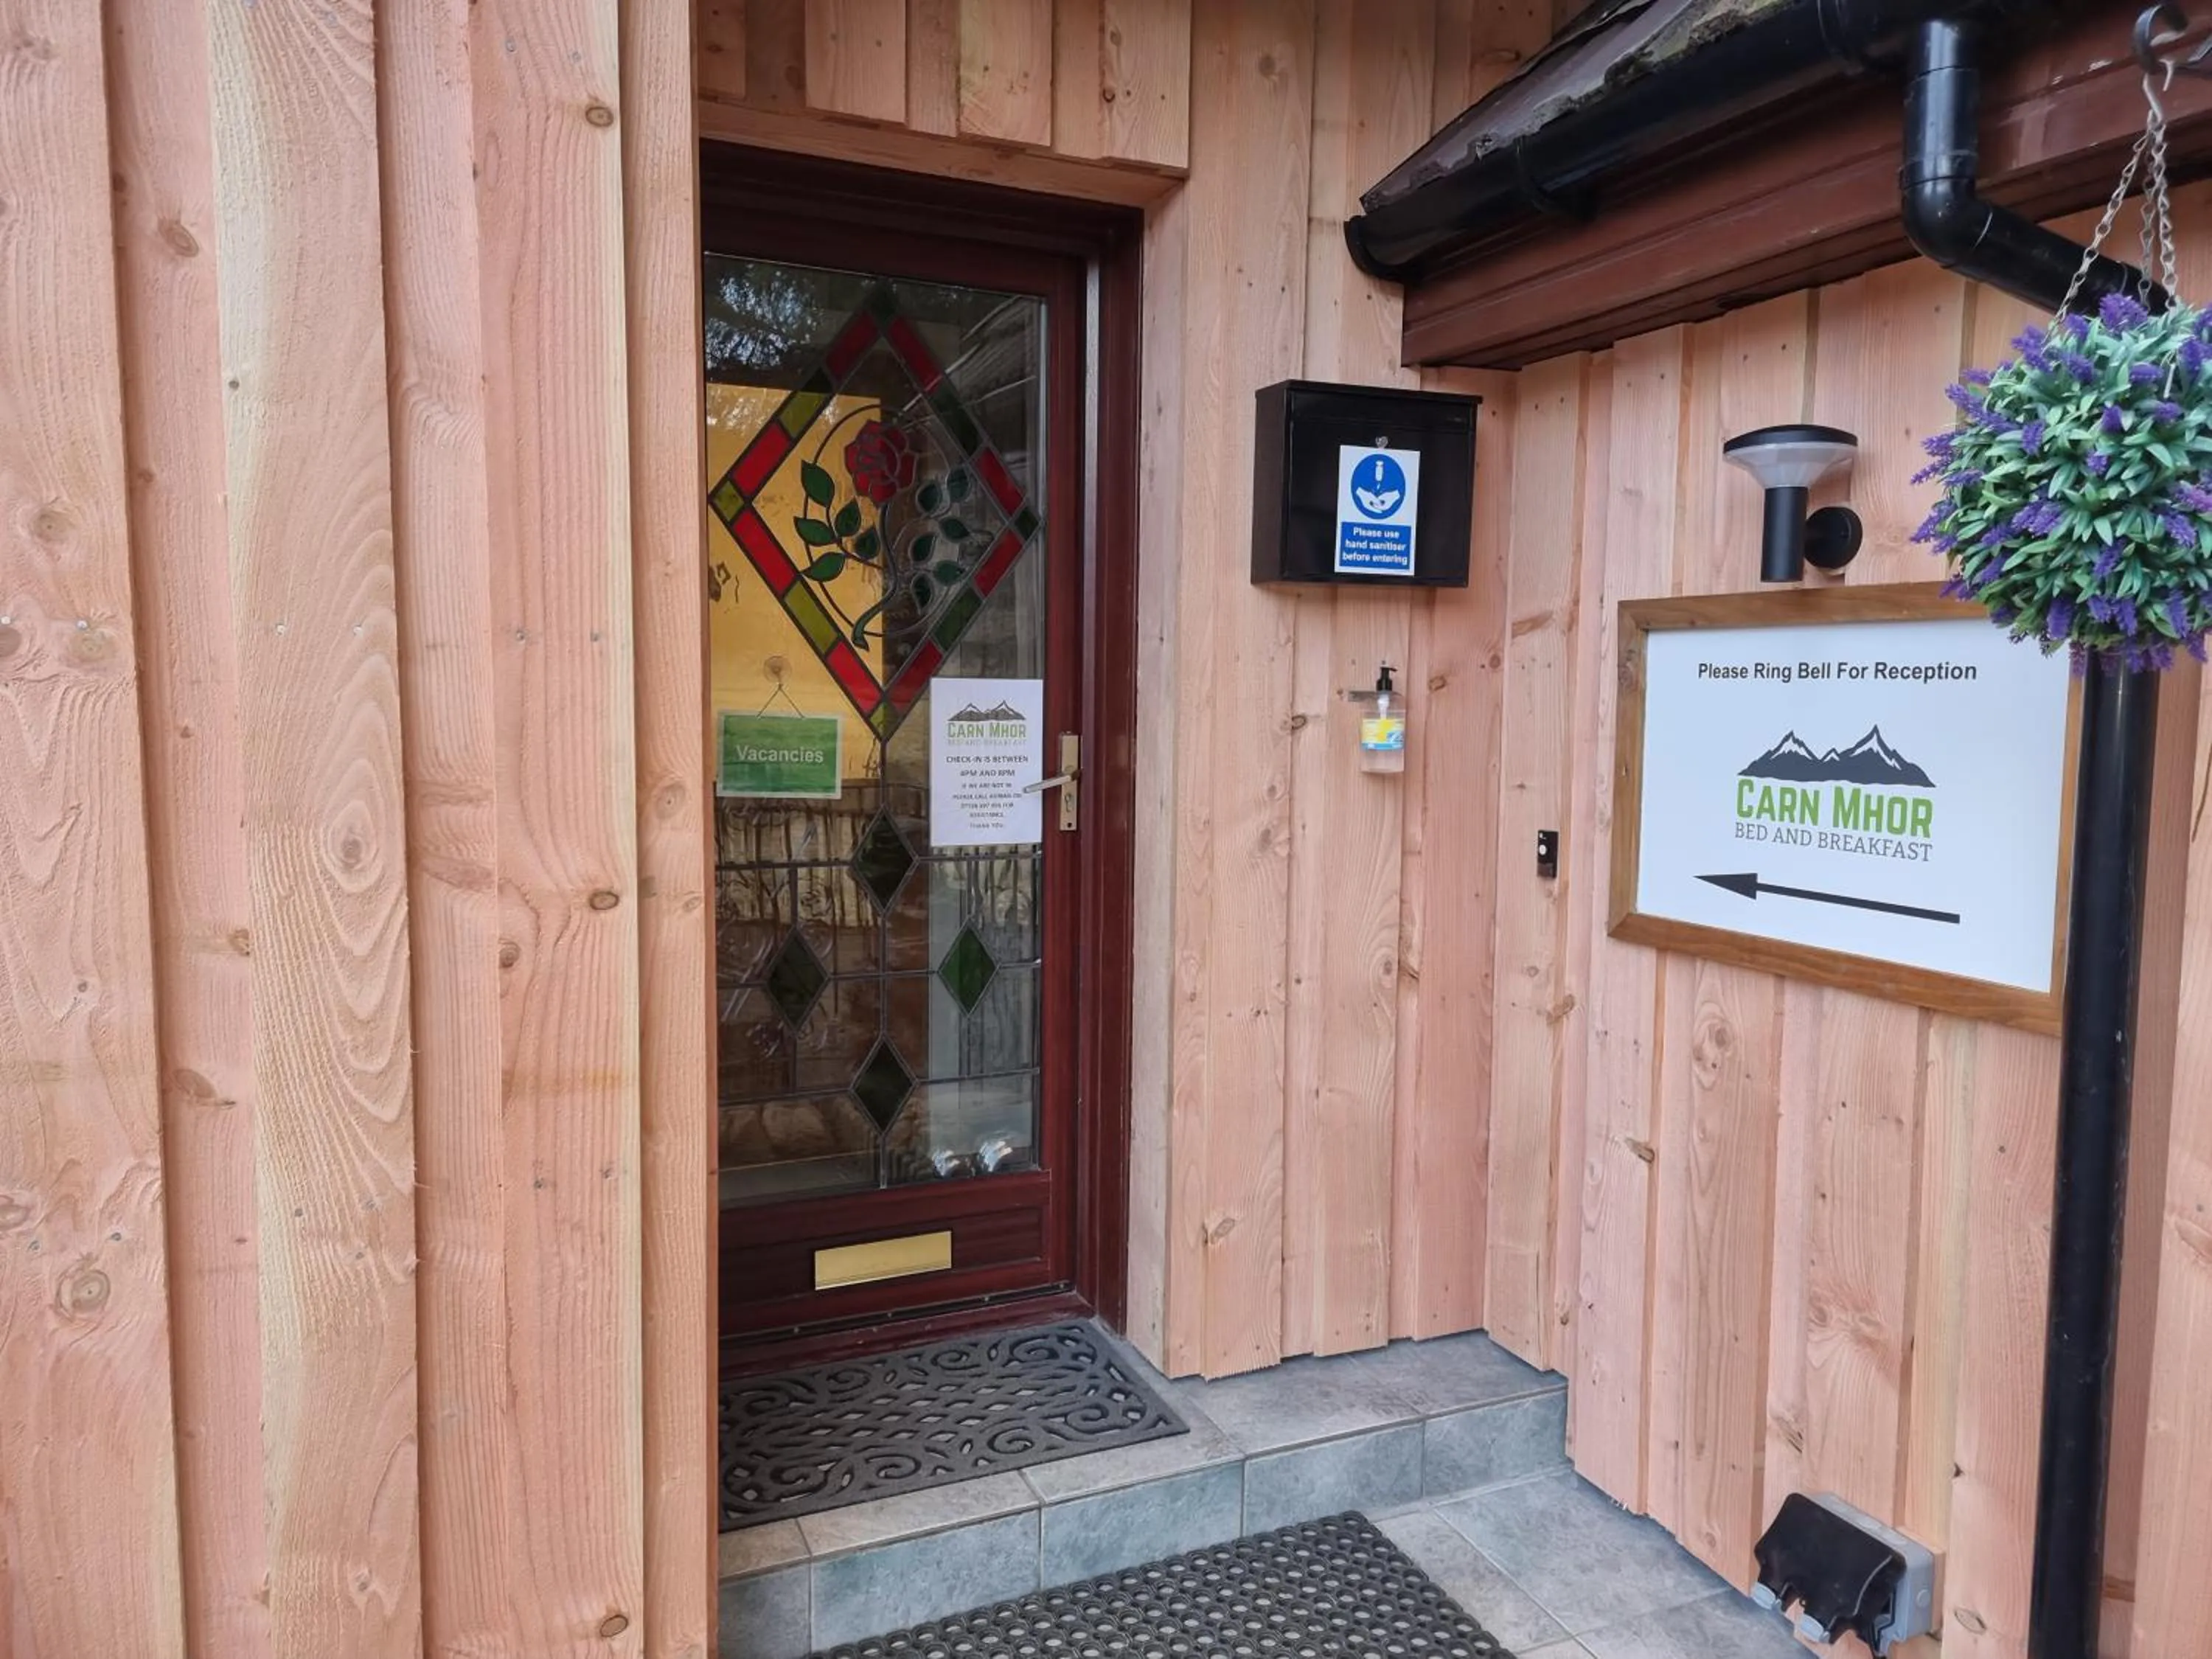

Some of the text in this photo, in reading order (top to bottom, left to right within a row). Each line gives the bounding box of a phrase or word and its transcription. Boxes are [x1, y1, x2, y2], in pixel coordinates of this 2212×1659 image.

[1353, 527, 1382, 538] Please
[1345, 539, 1407, 552] hand sanitiser
[1342, 552, 1408, 566] before entering
[1697, 661, 1978, 684] Please Ring Bell For Reception
[947, 721, 1027, 738] CARN MHOR
[736, 745, 824, 764] Vacancies
[992, 755, 1029, 764] BETWEEN
[1736, 778, 1934, 839] CARN MHOR
[1734, 821, 1933, 863] BED AND BREAKFAST
